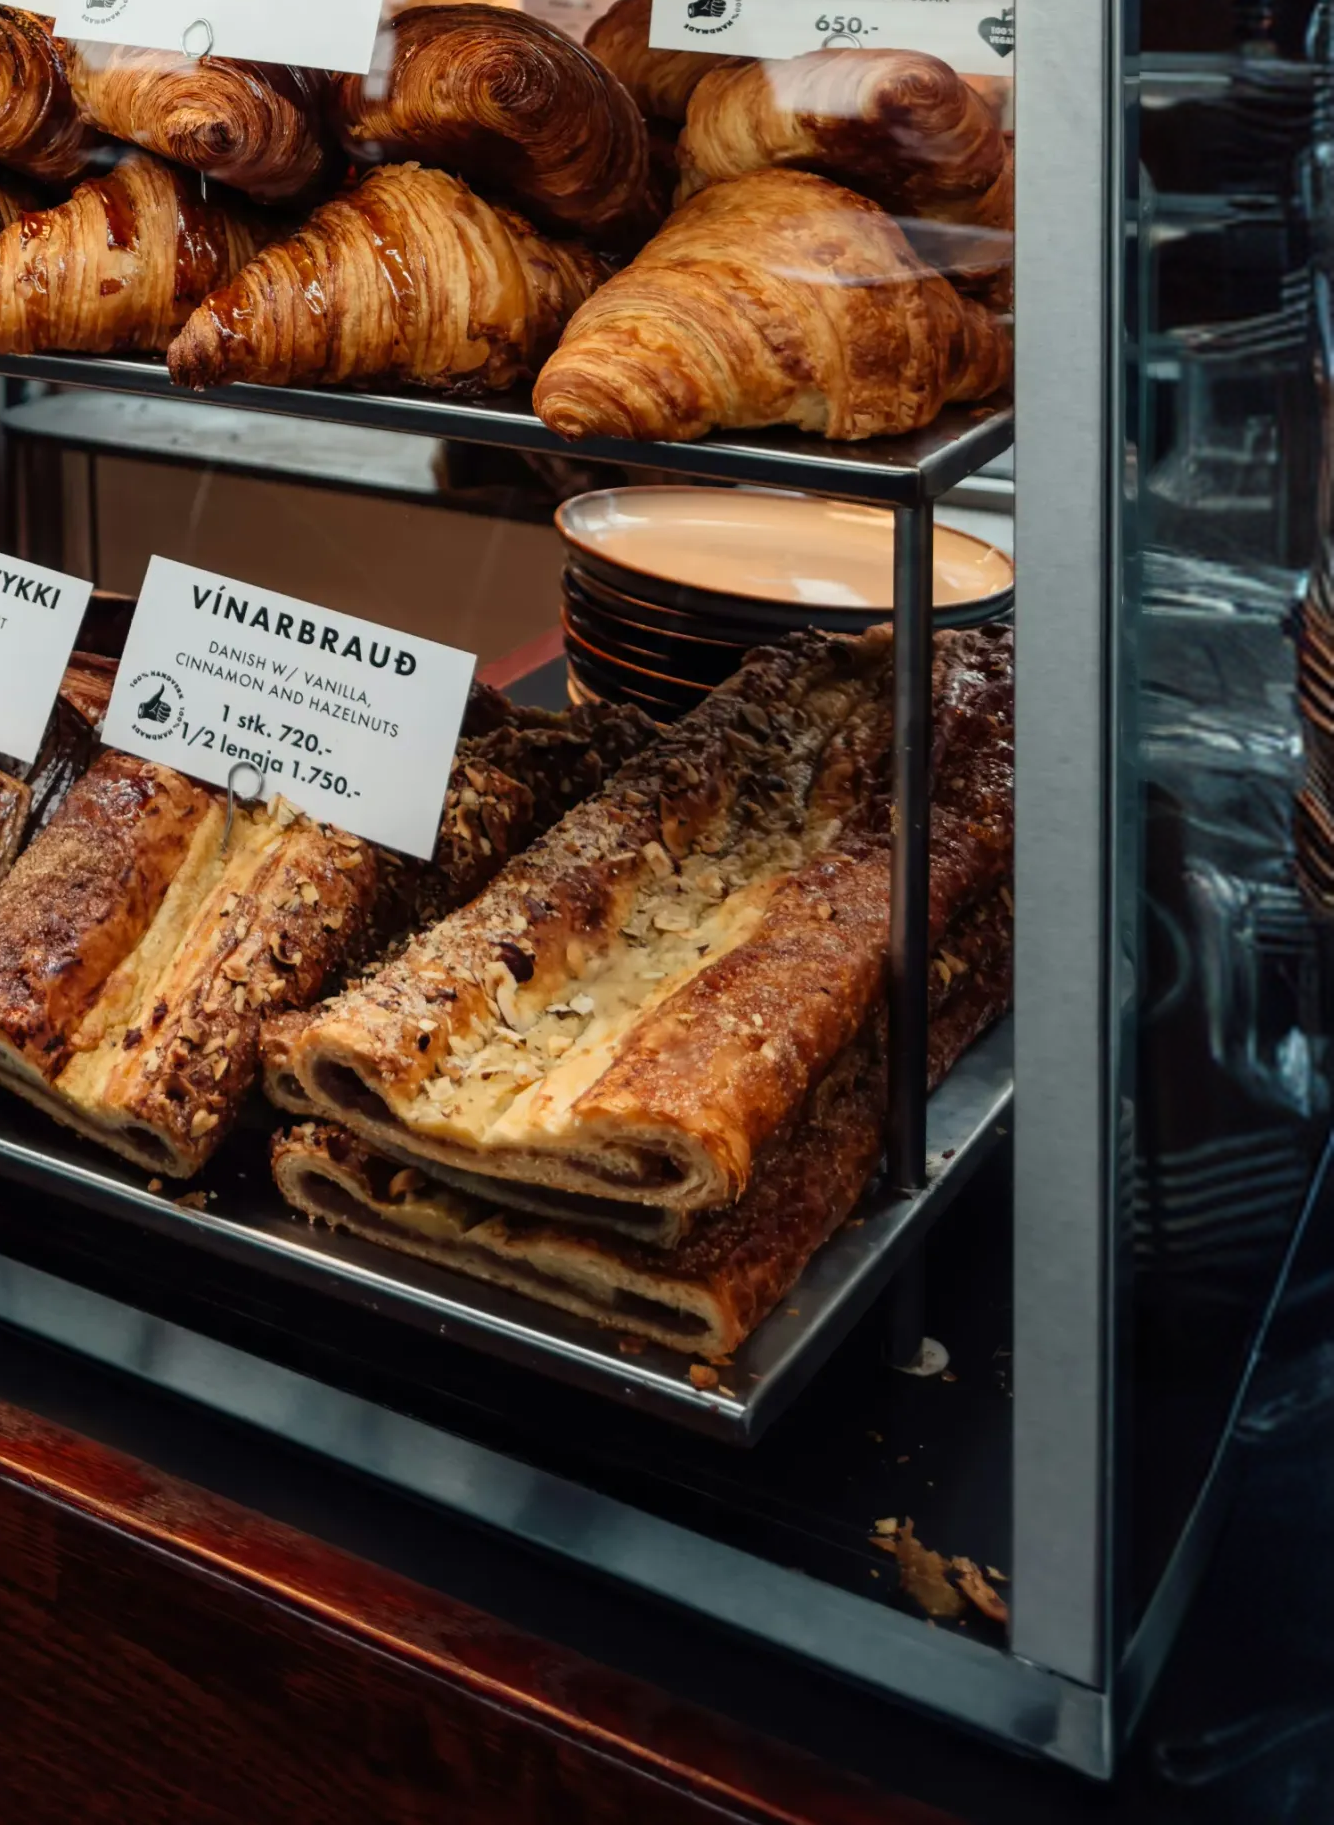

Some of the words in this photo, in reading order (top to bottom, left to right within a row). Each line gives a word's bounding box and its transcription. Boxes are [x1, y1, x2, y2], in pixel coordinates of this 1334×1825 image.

[814, 14, 880, 35] 650.-
[193, 585, 417, 677] VÍNARBRAUÐ
[175, 652, 265, 692] CINNAMON
[268, 684, 304, 705] AND
[308, 696, 399, 738] HAZELNUTS
[208, 640, 267, 671] DANISH
[272, 661, 298, 682] W/
[304, 671, 371, 709] VANILLA,
[177, 713, 216, 750] 1/2
[219, 733, 284, 775] lengja
[292, 760, 361, 798] 1.750.-
[222, 704, 230, 722] 1
[237, 713, 272, 738] stk.
[278, 724, 332, 756] 720.-
